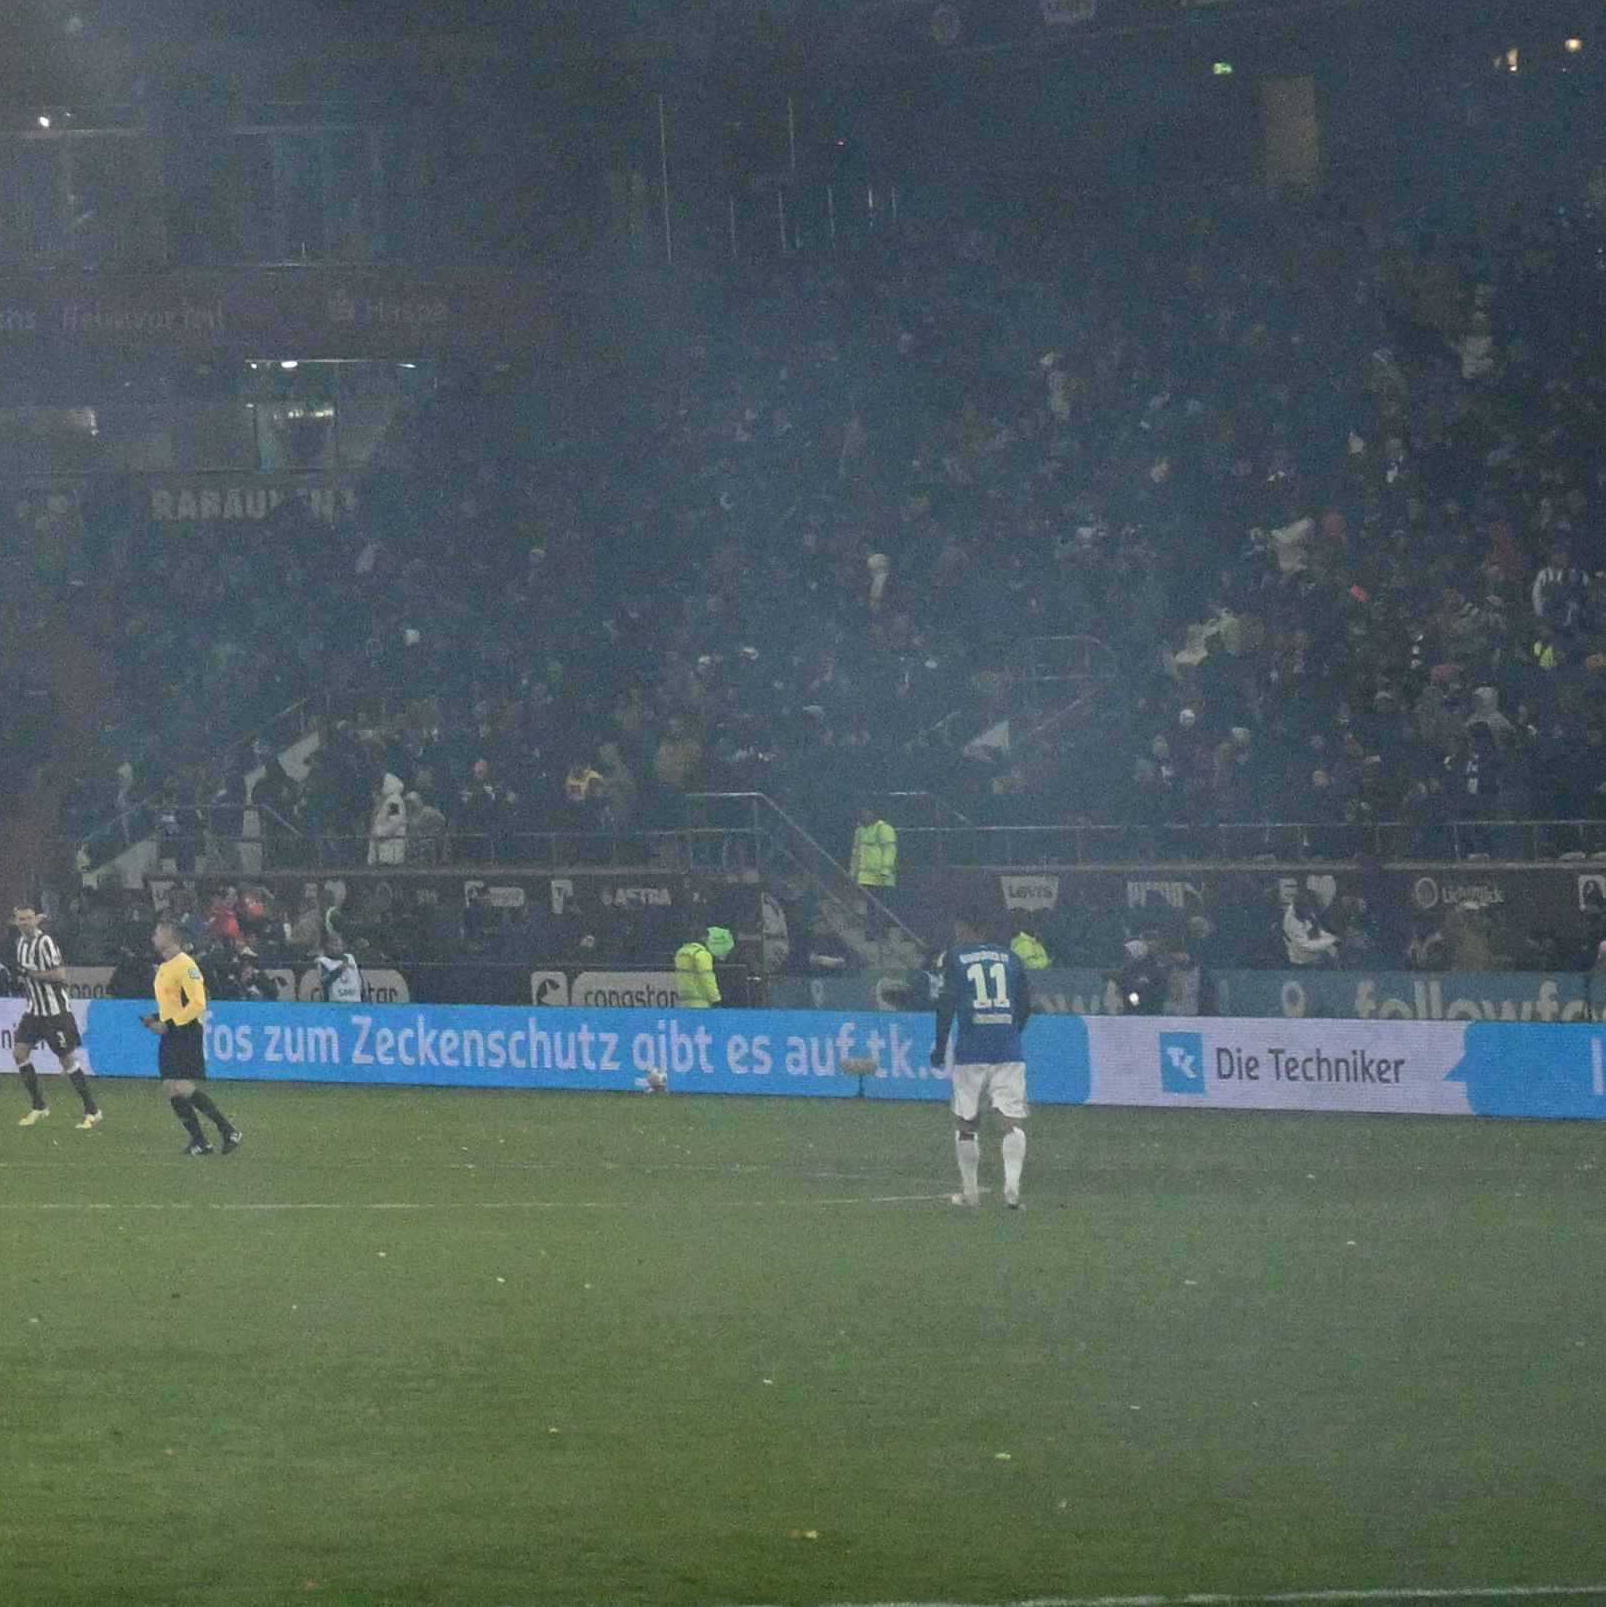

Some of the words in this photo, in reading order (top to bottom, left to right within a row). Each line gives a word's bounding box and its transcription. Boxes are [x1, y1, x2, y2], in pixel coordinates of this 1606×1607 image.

[967, 963, 1010, 1009] 11
[264, 1024, 340, 1064] zum
[352, 1014, 620, 1071] Zeckenschutz
[632, 1020, 714, 1079] gibt
[727, 1034, 772, 1074] es
[787, 1022, 856, 1077] auf
[1216, 1047, 1260, 1081] Die
[1268, 1048, 1406, 1084] Techniker
